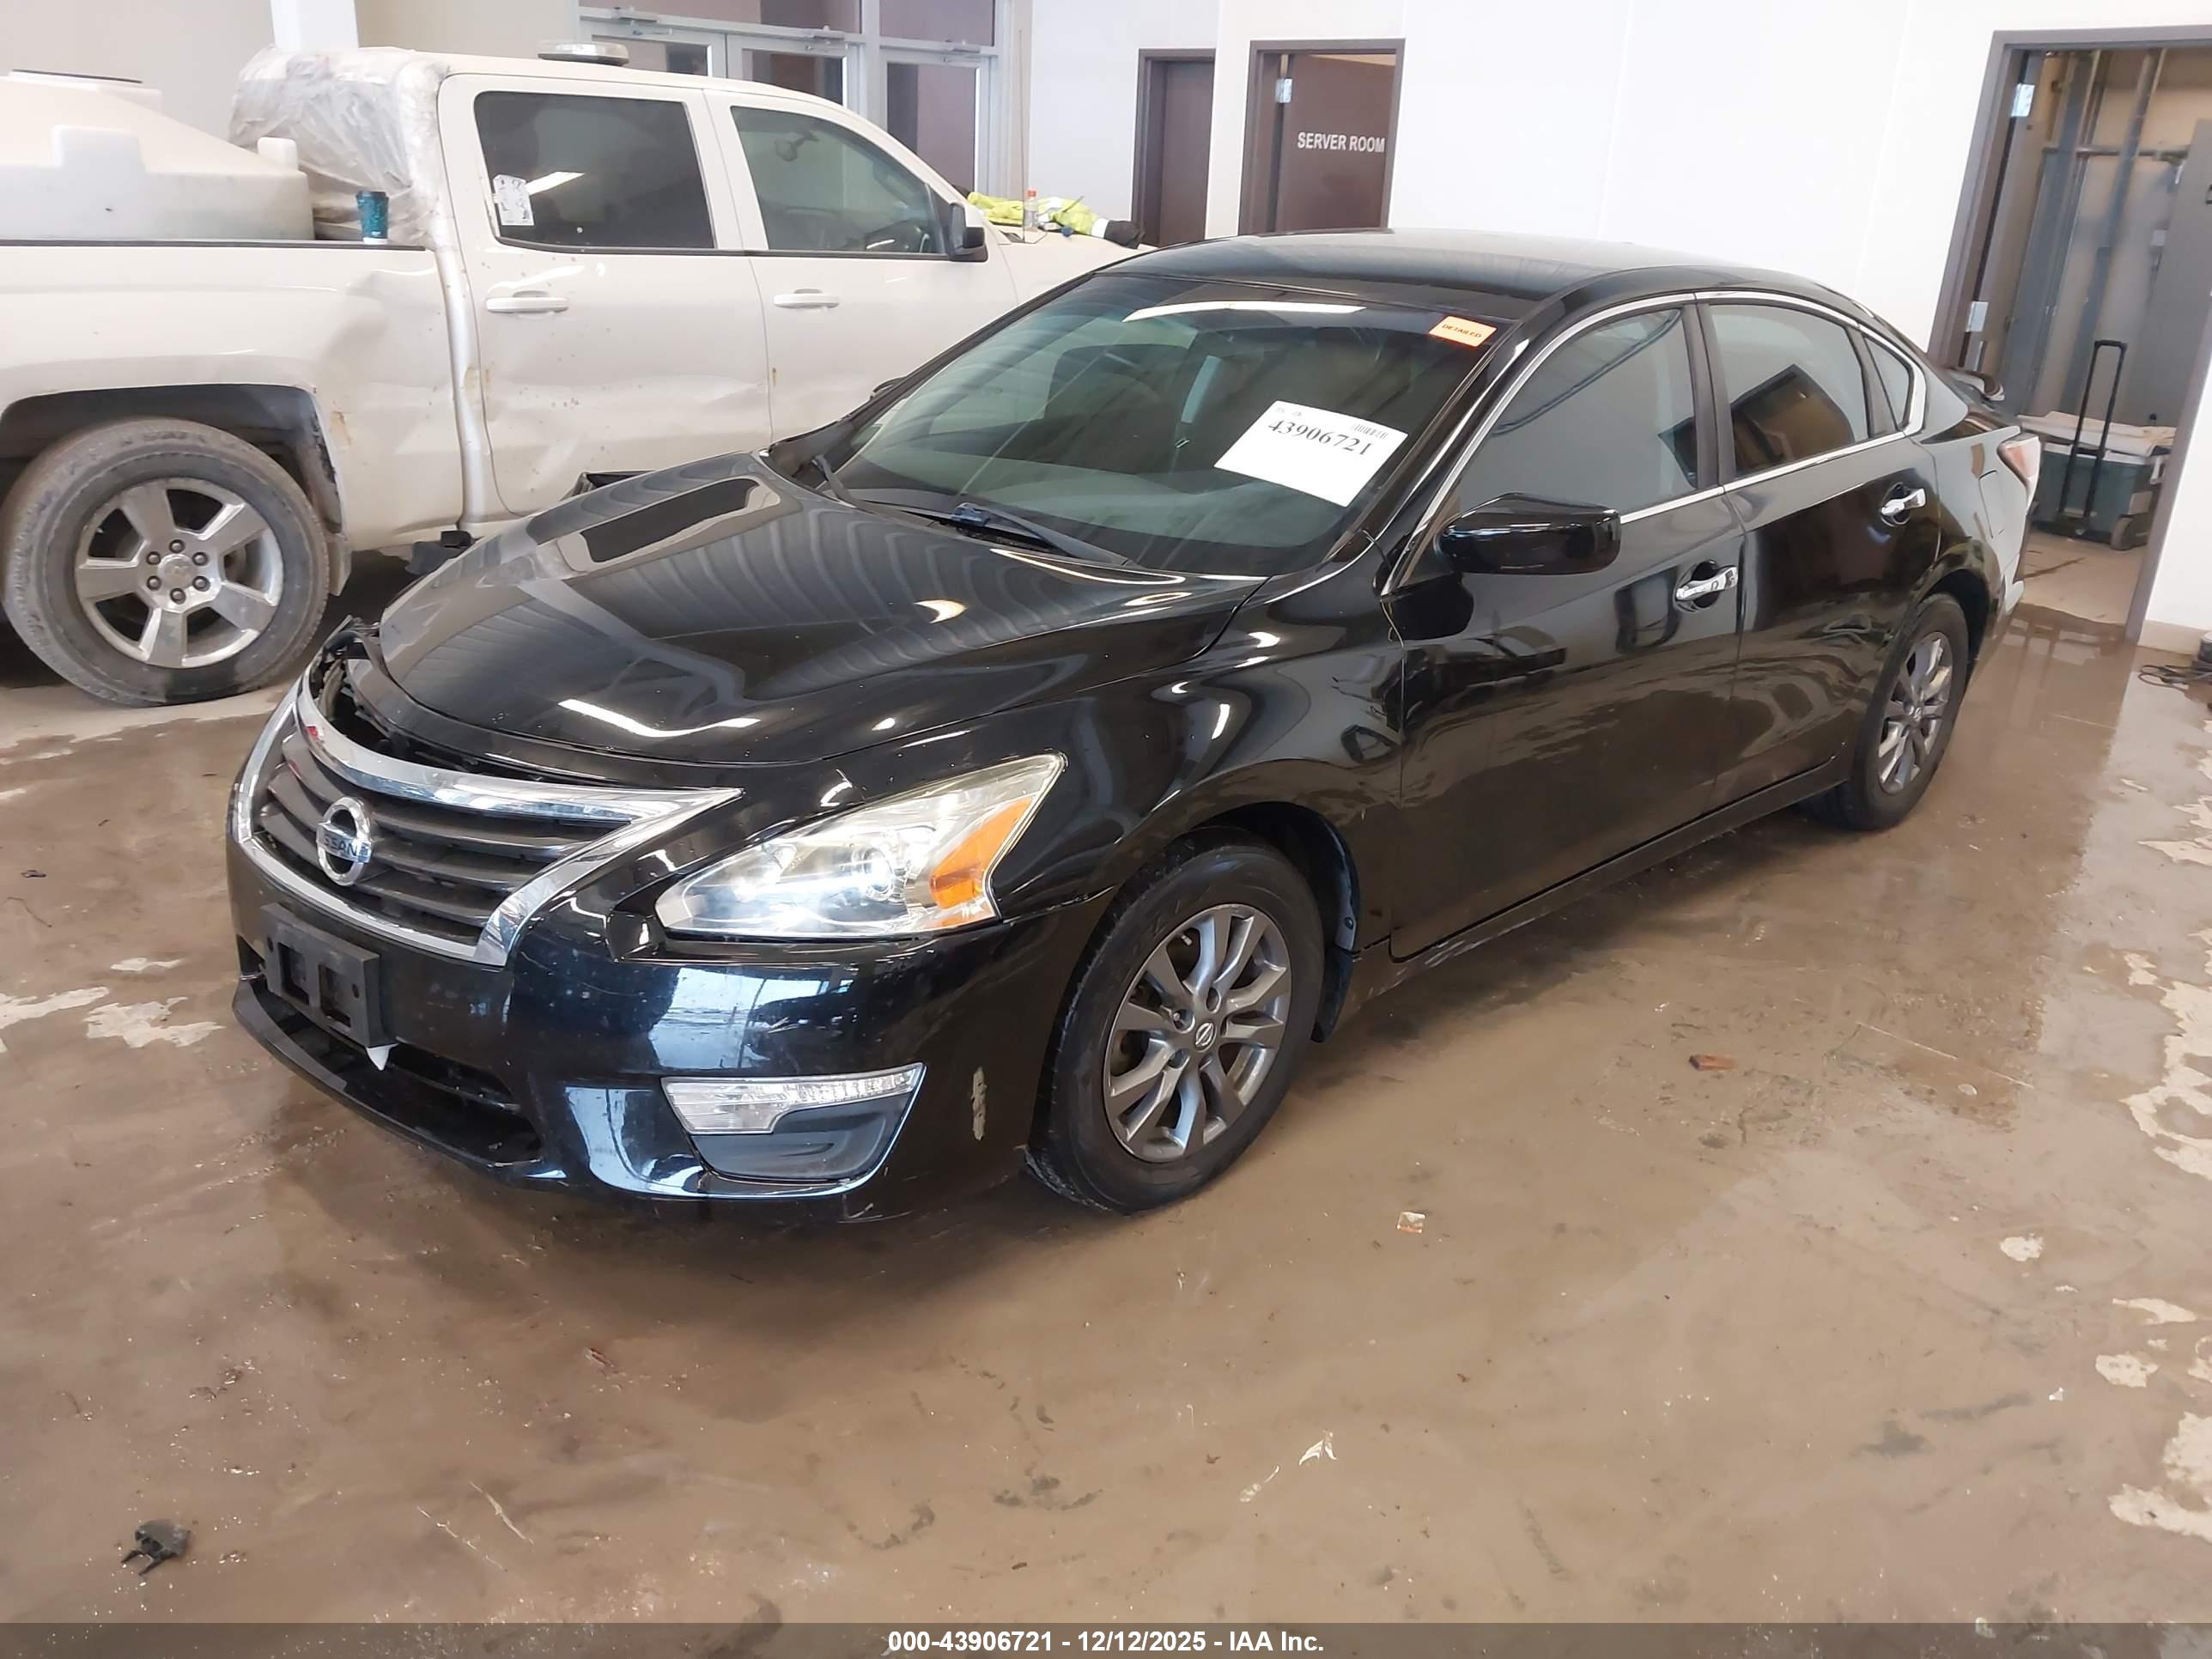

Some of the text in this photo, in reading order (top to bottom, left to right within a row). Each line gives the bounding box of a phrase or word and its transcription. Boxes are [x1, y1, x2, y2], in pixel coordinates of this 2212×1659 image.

[1297, 131, 1386, 153] SERVER ROOM
[1442, 324, 1482, 338] DETAILED
[1267, 419, 1373, 456] 43906721
